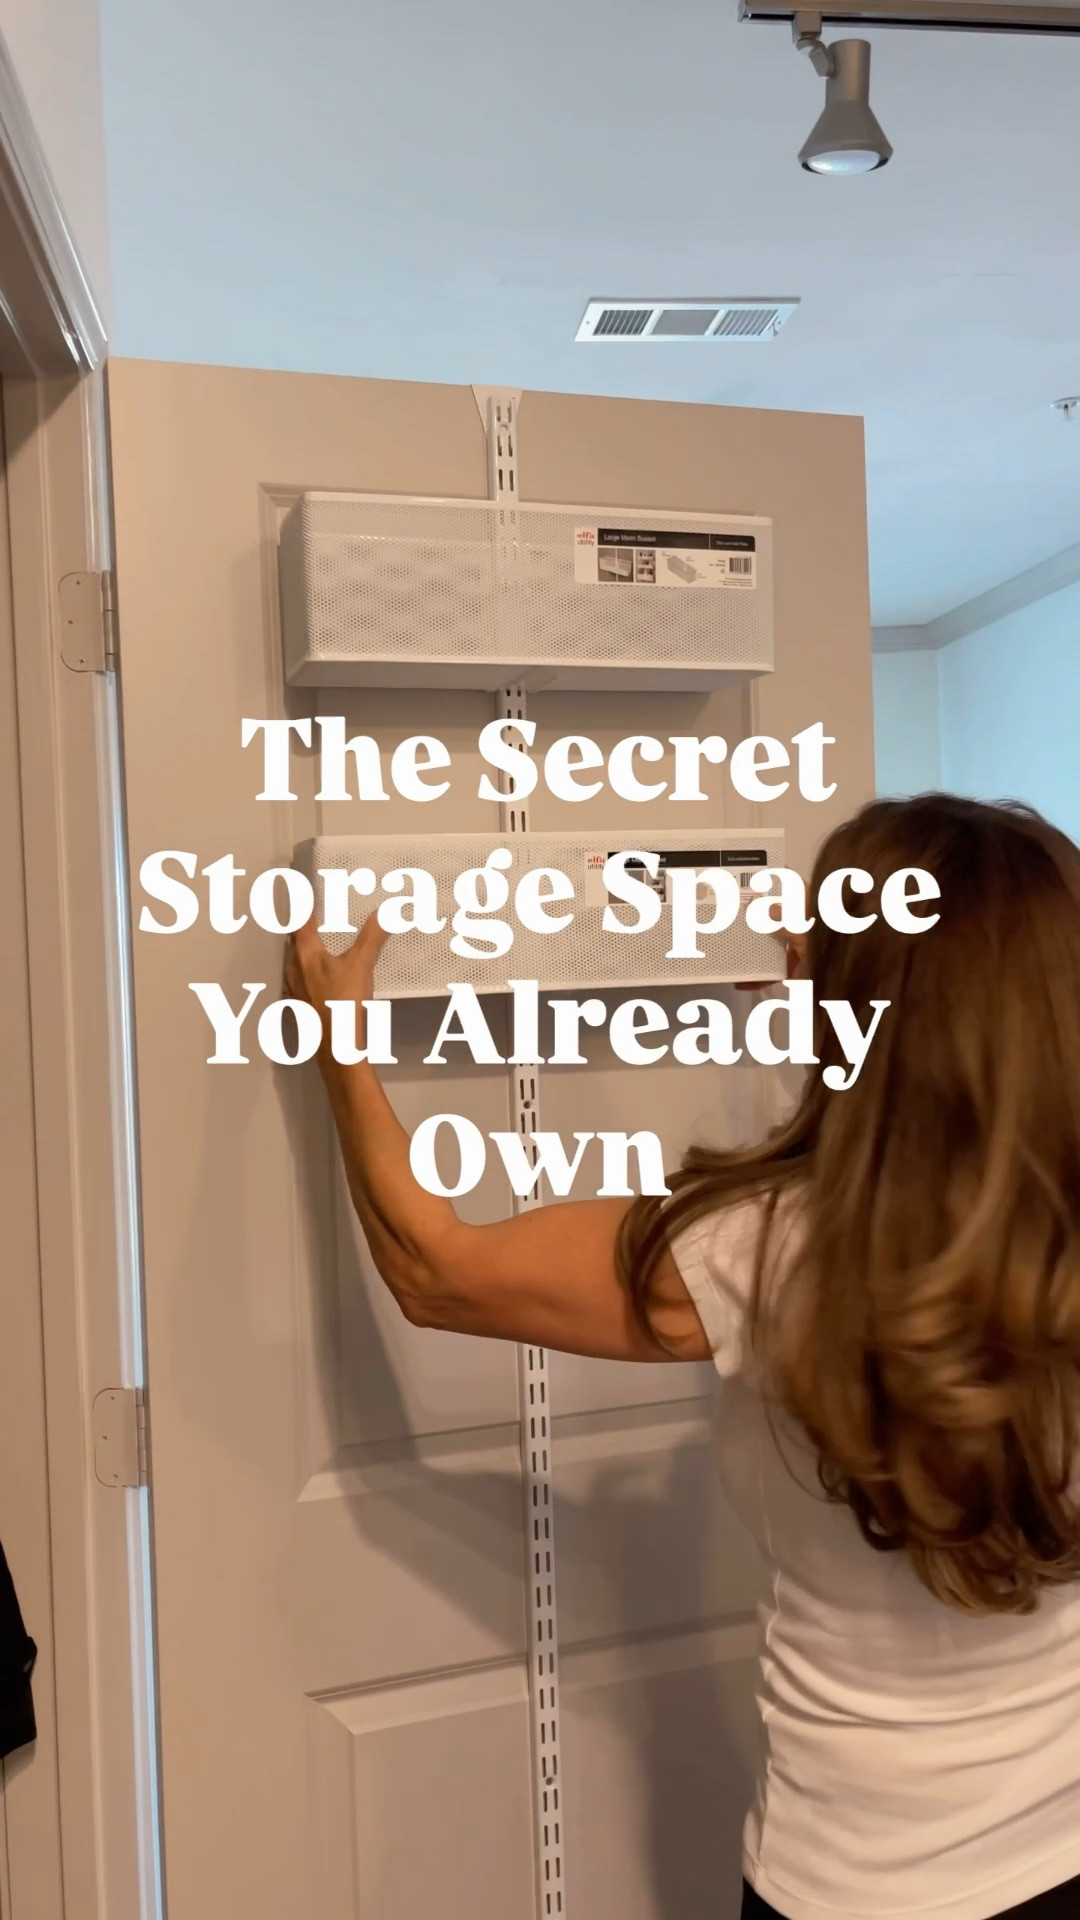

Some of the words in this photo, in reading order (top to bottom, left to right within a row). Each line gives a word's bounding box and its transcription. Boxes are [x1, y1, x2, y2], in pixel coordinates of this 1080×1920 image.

[577, 531, 595, 539] elfa
[603, 533, 620, 542] Large
[577, 539, 595, 547] utility
